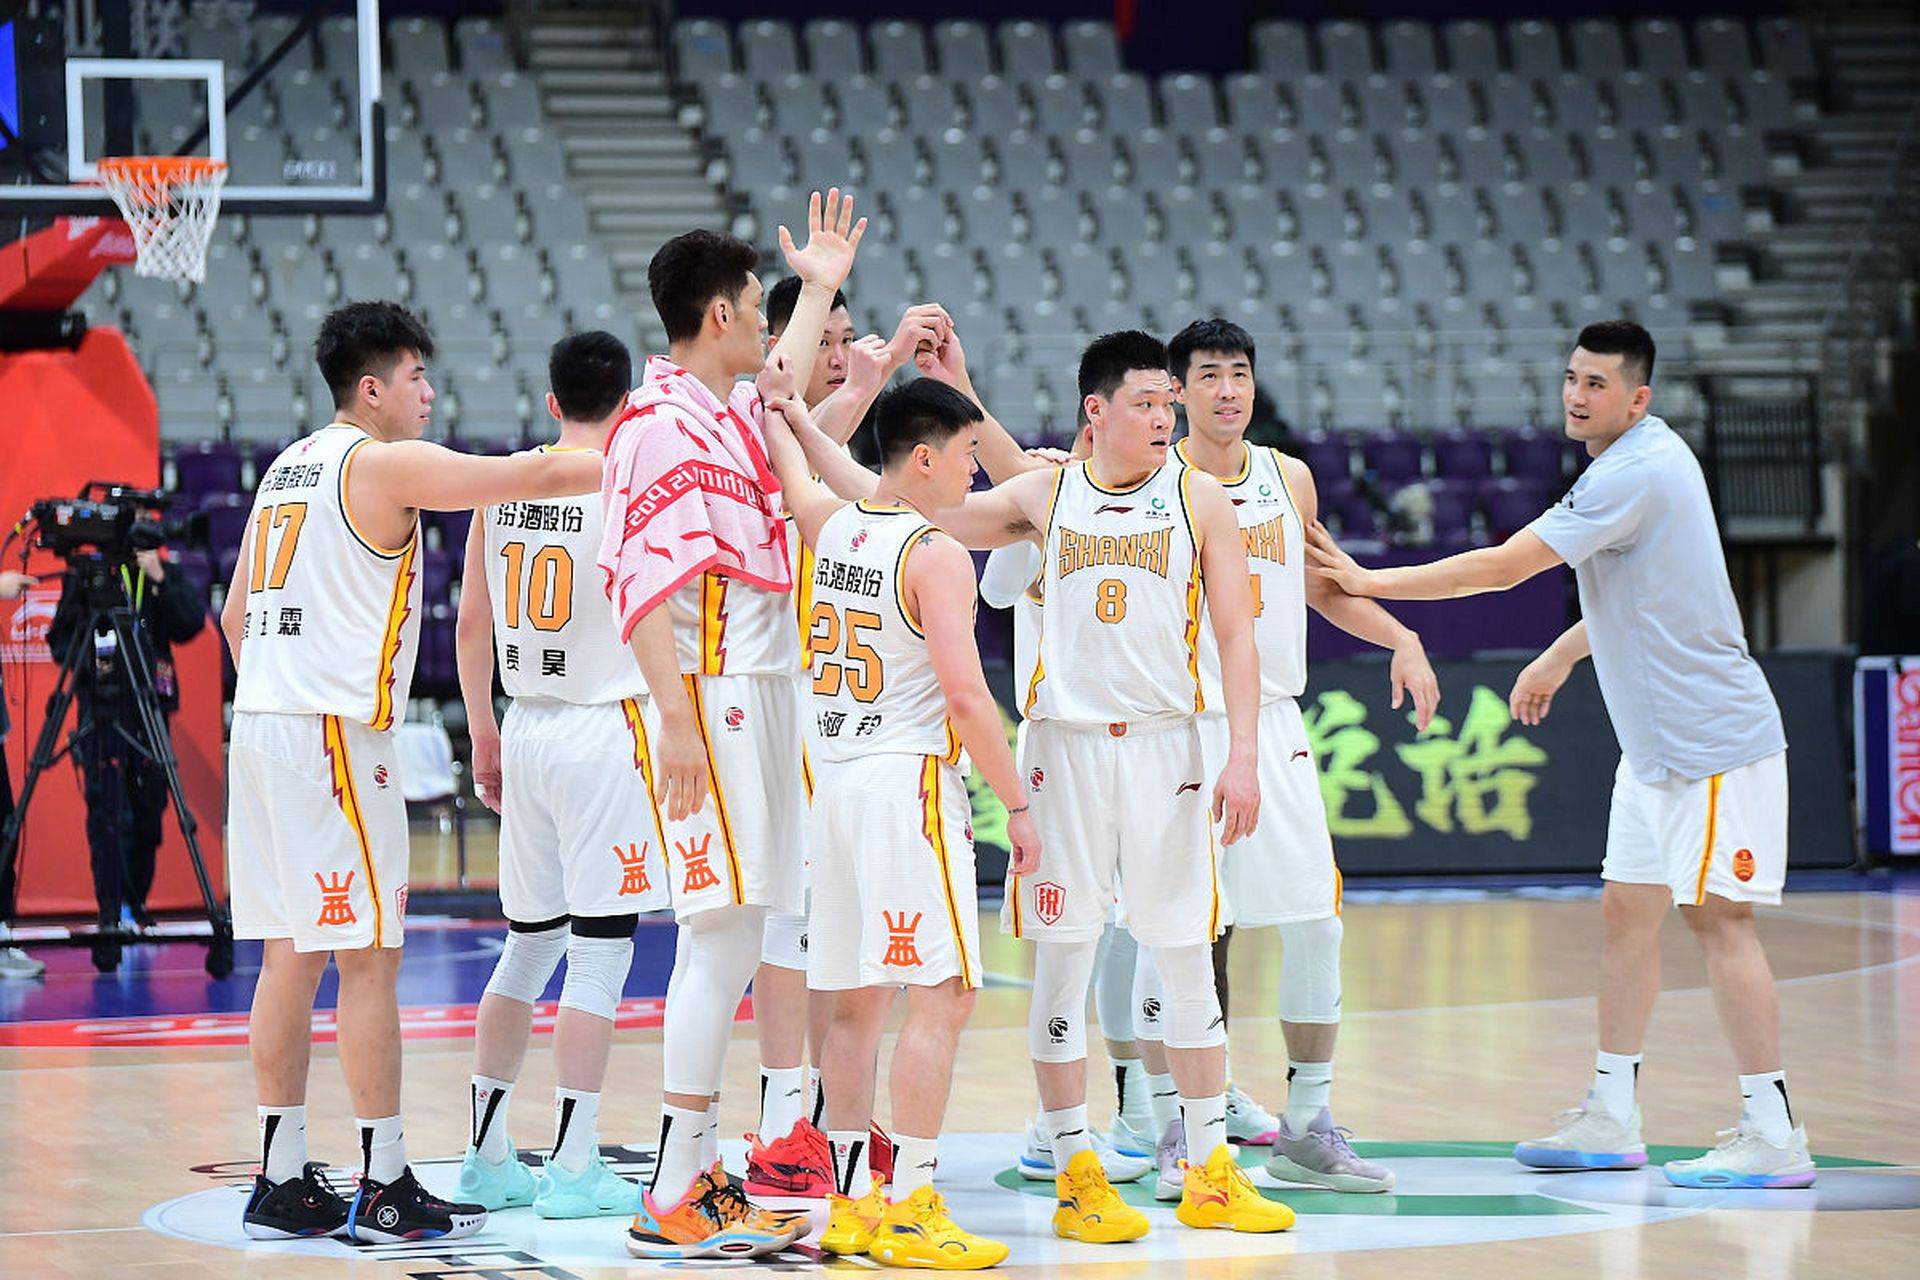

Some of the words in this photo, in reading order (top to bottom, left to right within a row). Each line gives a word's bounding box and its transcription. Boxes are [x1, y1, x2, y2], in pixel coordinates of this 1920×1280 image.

[497, 502, 584, 533] 汾酒股份
[1239, 513, 1286, 566] NXI
[251, 502, 308, 593] 17
[1058, 525, 1175, 580] SHANXI
[500, 541, 574, 632] 10
[1095, 578, 1127, 624] 8
[811, 601, 884, 703] 25
